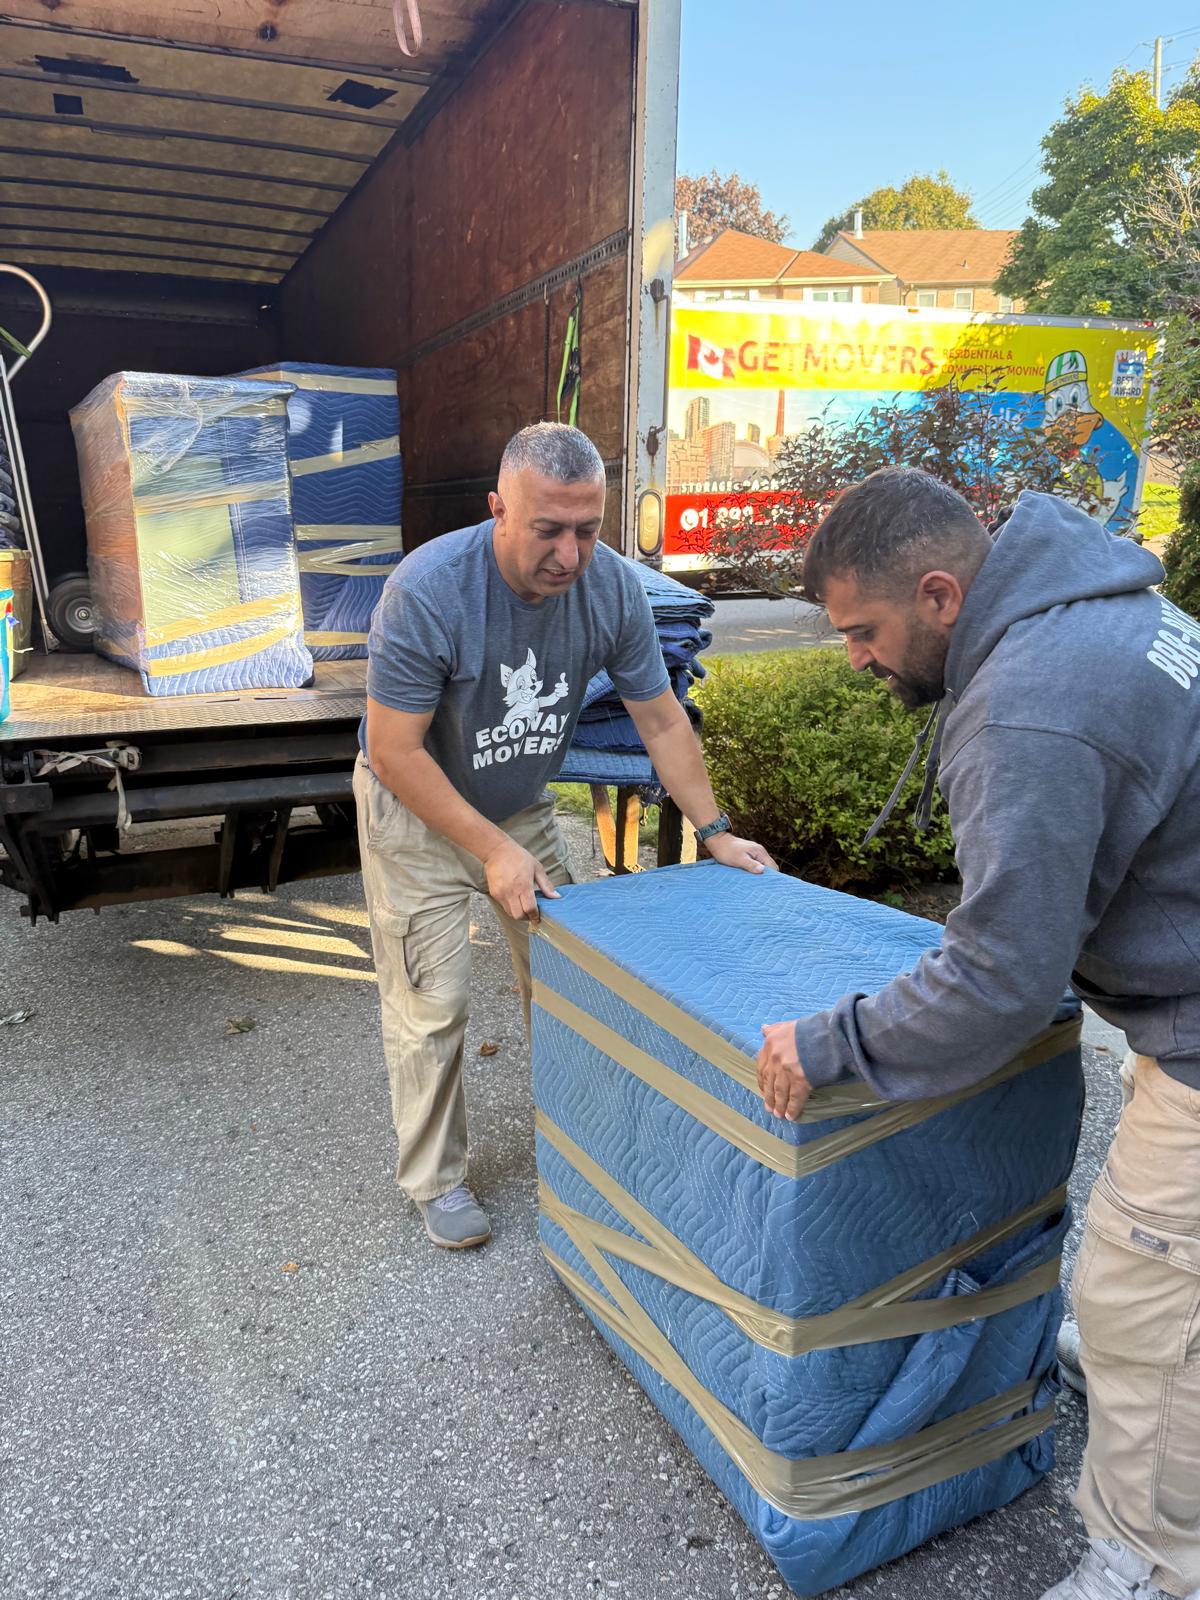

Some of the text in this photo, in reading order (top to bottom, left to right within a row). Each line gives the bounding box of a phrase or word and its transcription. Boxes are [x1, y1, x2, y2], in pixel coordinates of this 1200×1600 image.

[738, 340, 936, 375] GETMOVERS
[943, 348, 1014, 360] RESIDENTIAL &
[1007, 366, 1046, 377] MOVING
[1114, 387, 1141, 396] AWARD
[681, 480, 732, 493] STORAGE
[475, 711, 571, 749] ECOWAY
[472, 732, 565, 771] MOVERS
